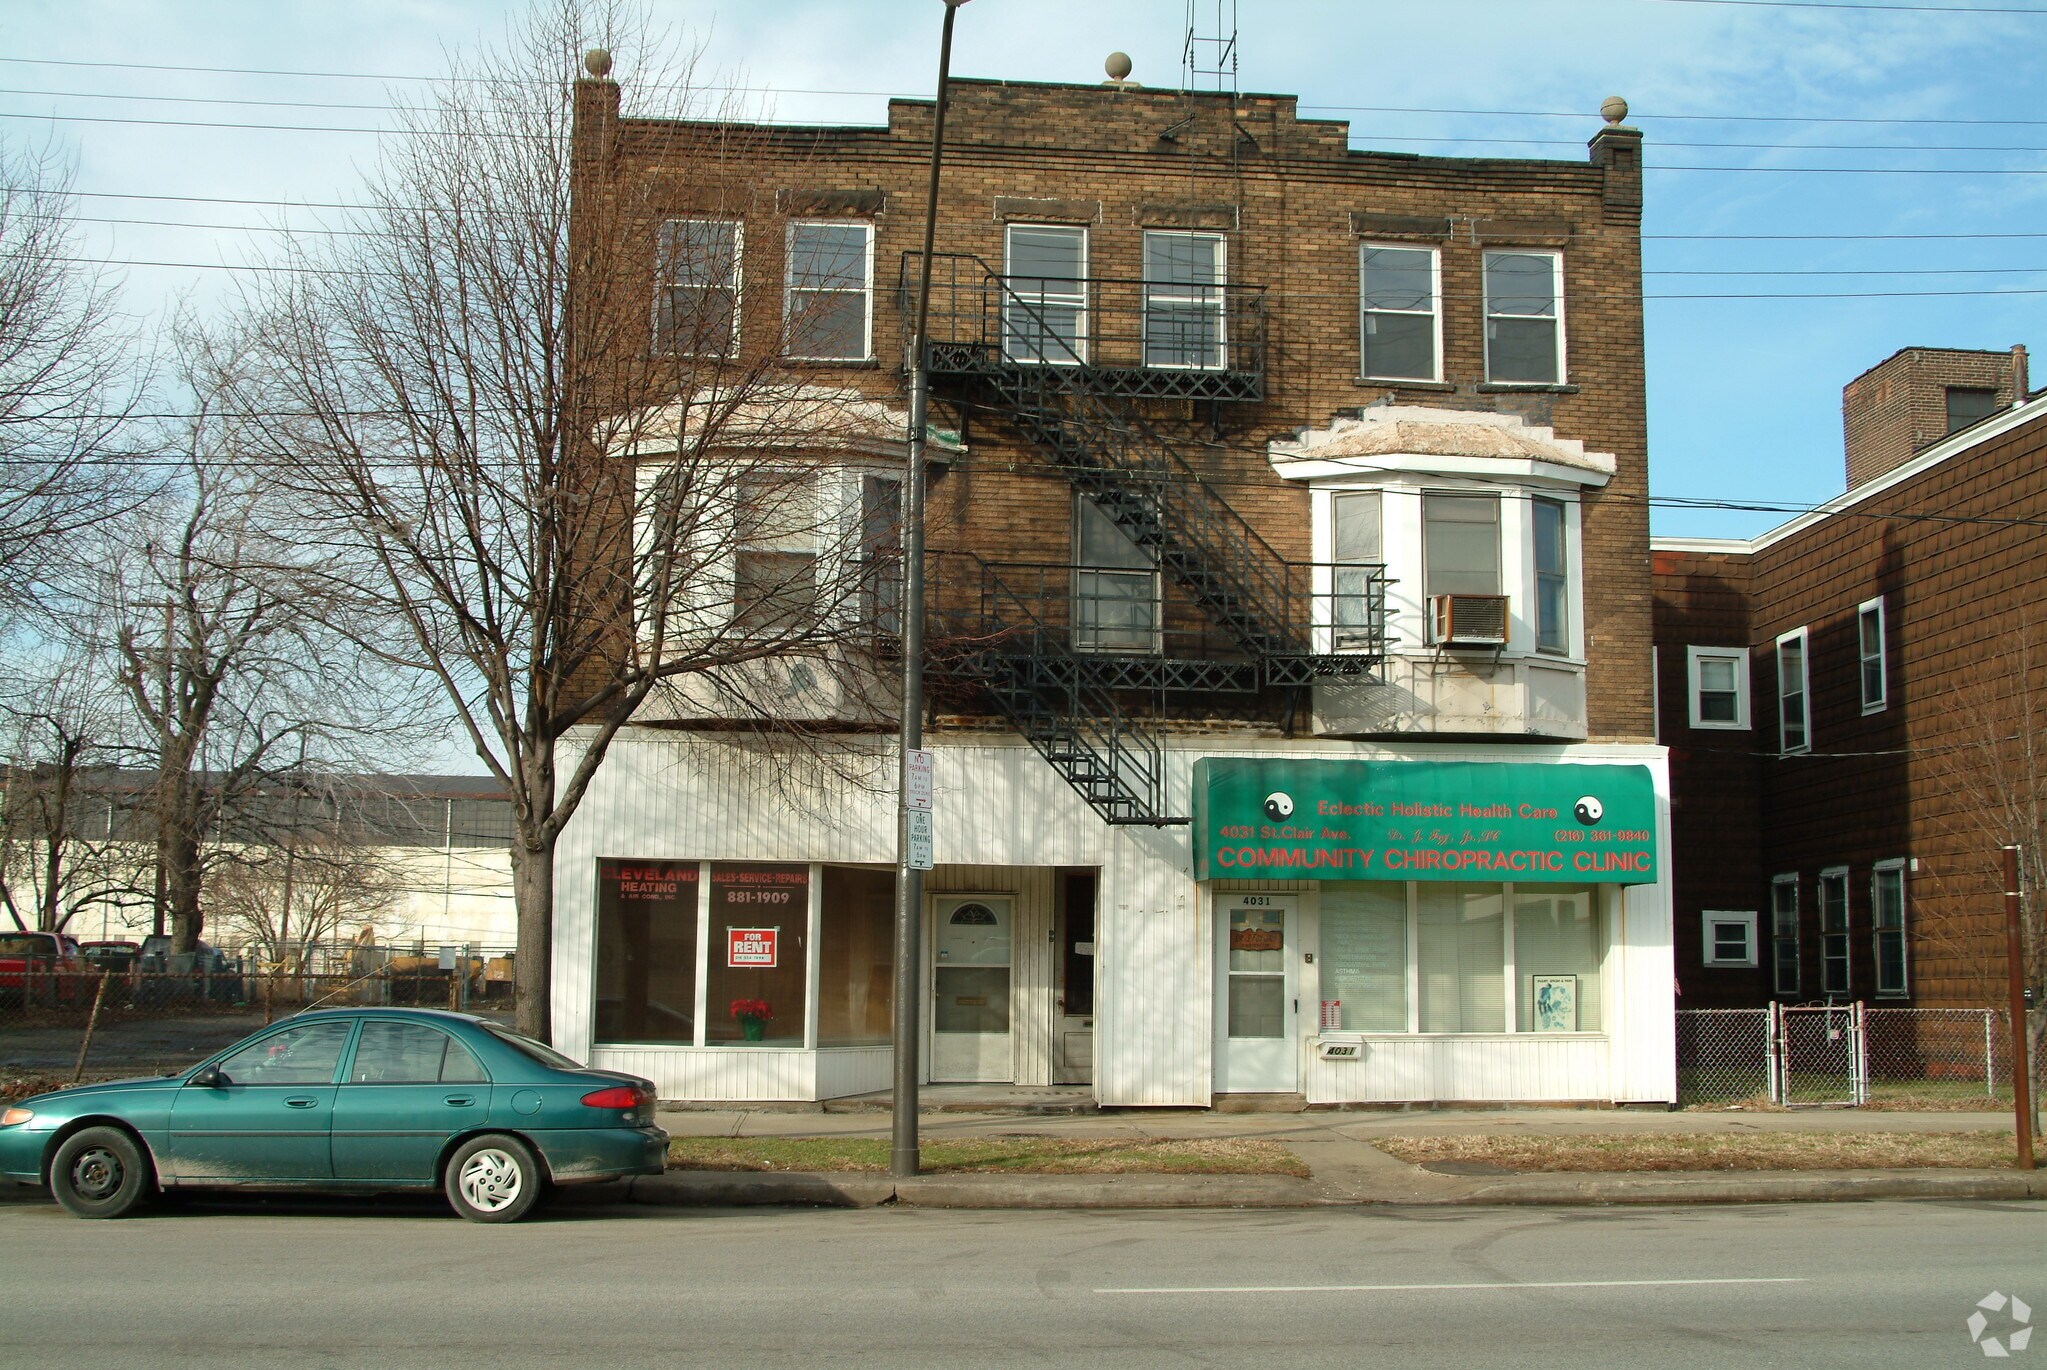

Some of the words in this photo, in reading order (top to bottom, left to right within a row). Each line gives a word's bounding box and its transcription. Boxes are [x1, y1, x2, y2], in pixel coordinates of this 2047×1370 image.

[914, 755, 925, 765] NO
[909, 763, 930, 774] PARKING
[1317, 800, 1384, 817] Eclectic
[1391, 801, 1452, 818] Holistic
[1459, 803, 1512, 818] Health
[1518, 803, 1558, 819] Care
[915, 815, 926, 825] ONE
[914, 824, 928, 834] HOUR
[1219, 825, 1255, 839] 4031
[1321, 827, 1351, 840] Ave.
[910, 833, 931, 844] PARKING
[1554, 829, 1585, 842] (216)
[1217, 847, 1375, 869] COMMUNITY
[1384, 848, 1564, 871] CHIROPRACTIC
[1572, 851, 1651, 872] CLINIC
[601, 866, 698, 882] CLEVELAND
[620, 881, 677, 893] HEATING
[727, 891, 790, 904] 881-1909
[1243, 896, 1270, 906] 4031
[744, 933, 762, 941] FOR
[733, 941, 772, 953] RENT
[1327, 1046, 1356, 1056] 4031
